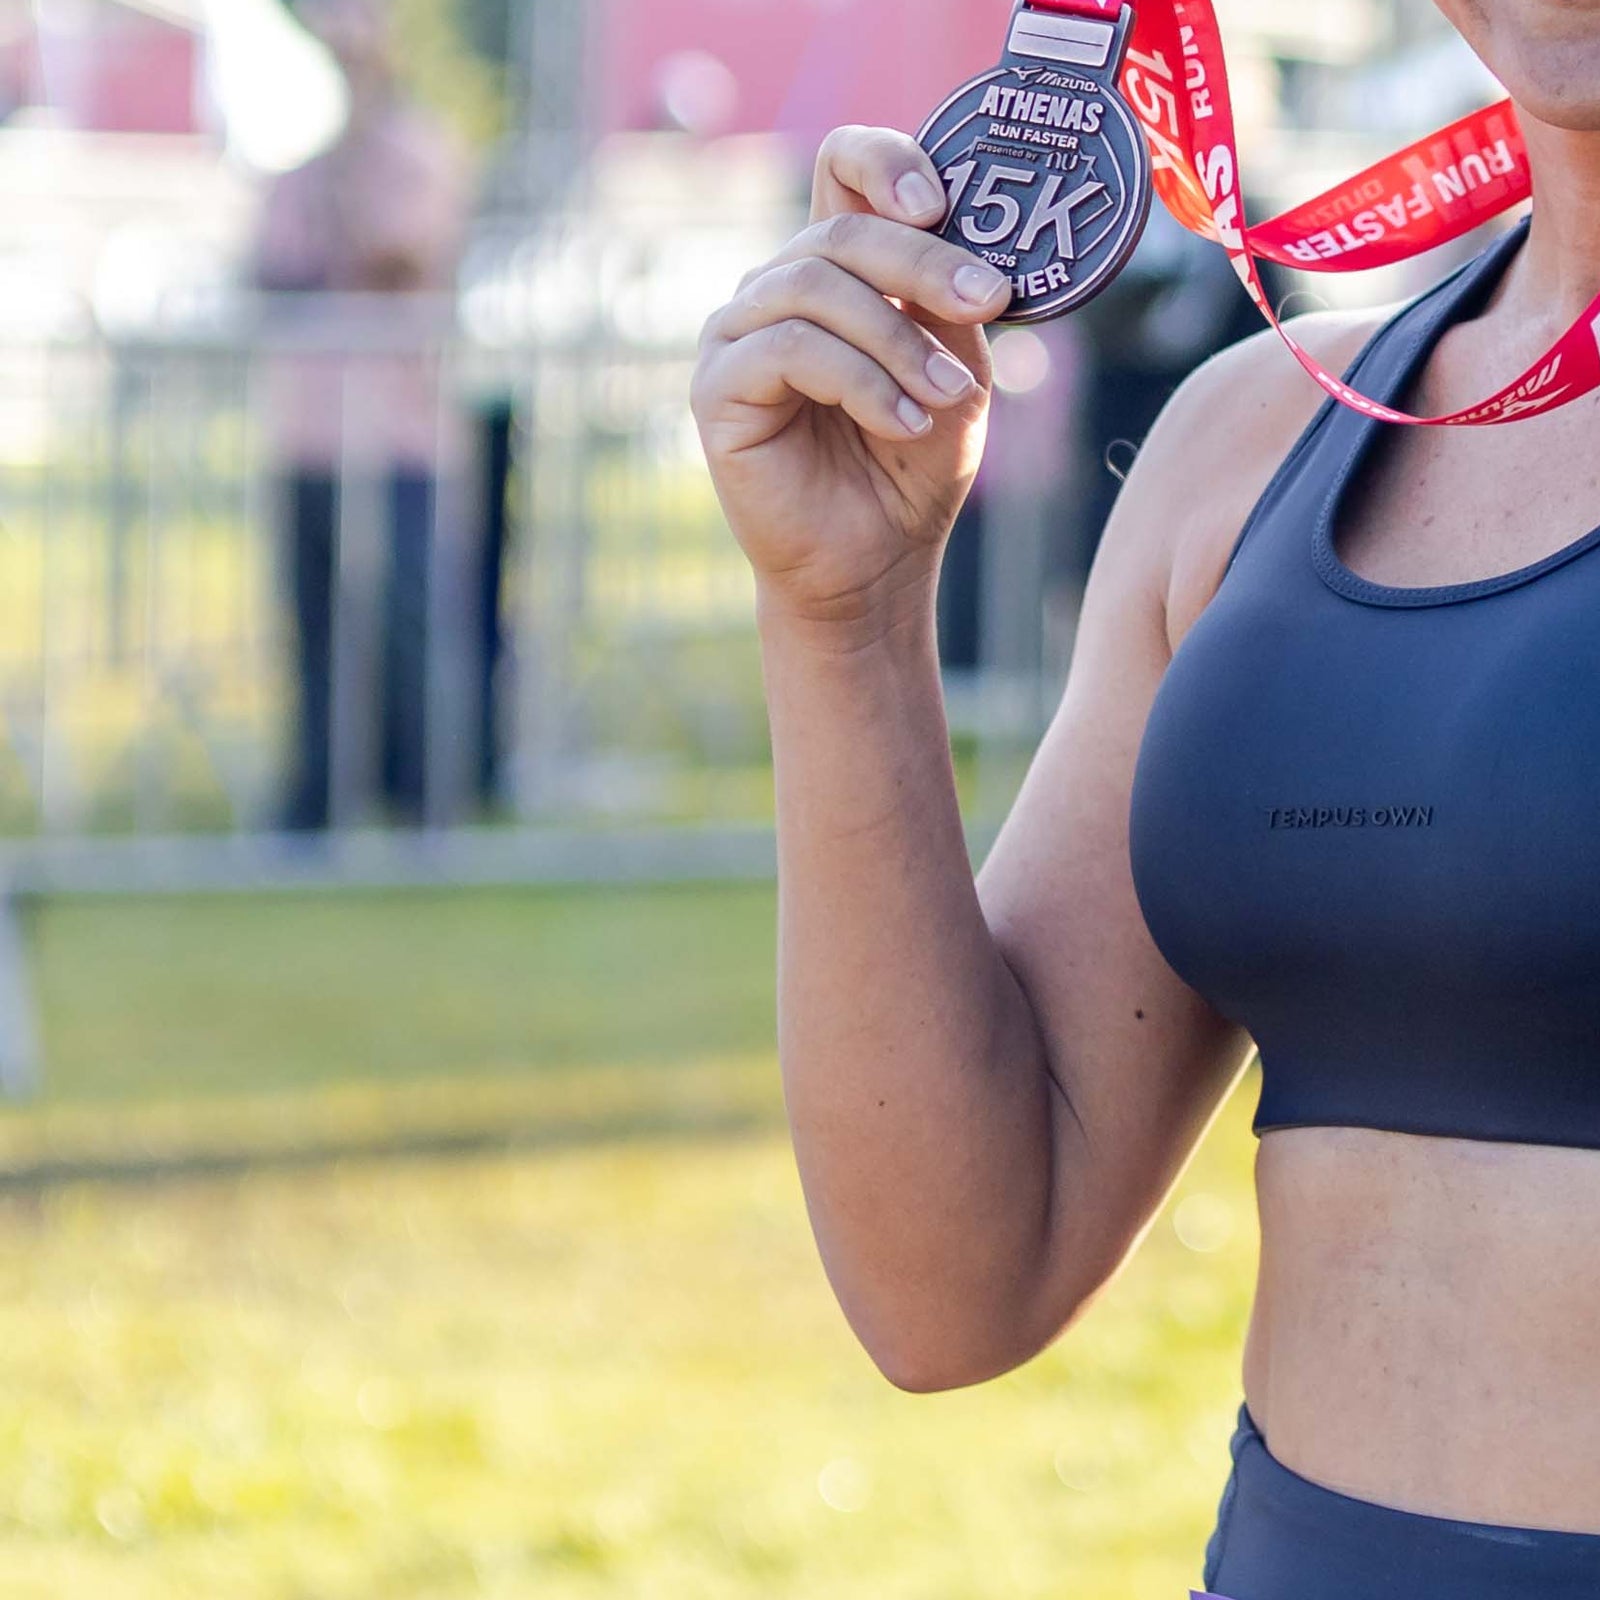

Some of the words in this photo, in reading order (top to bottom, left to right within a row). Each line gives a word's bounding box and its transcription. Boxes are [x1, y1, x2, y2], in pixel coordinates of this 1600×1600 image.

[978, 84, 1103, 132] ATHENAS
[976, 142, 1024, 158] presented
[1026, 151, 1037, 162] by
[989, 124, 1021, 141] RUN
[1023, 129, 1079, 149] FASTER
[1432, 139, 1515, 203] RUN
[939, 160, 1106, 259] 15K
[1283, 180, 1433, 262] FASTER
[980, 251, 1016, 268] 2026
[1266, 807, 1366, 829] TEMPUS
[1371, 805, 1434, 827] OWN
